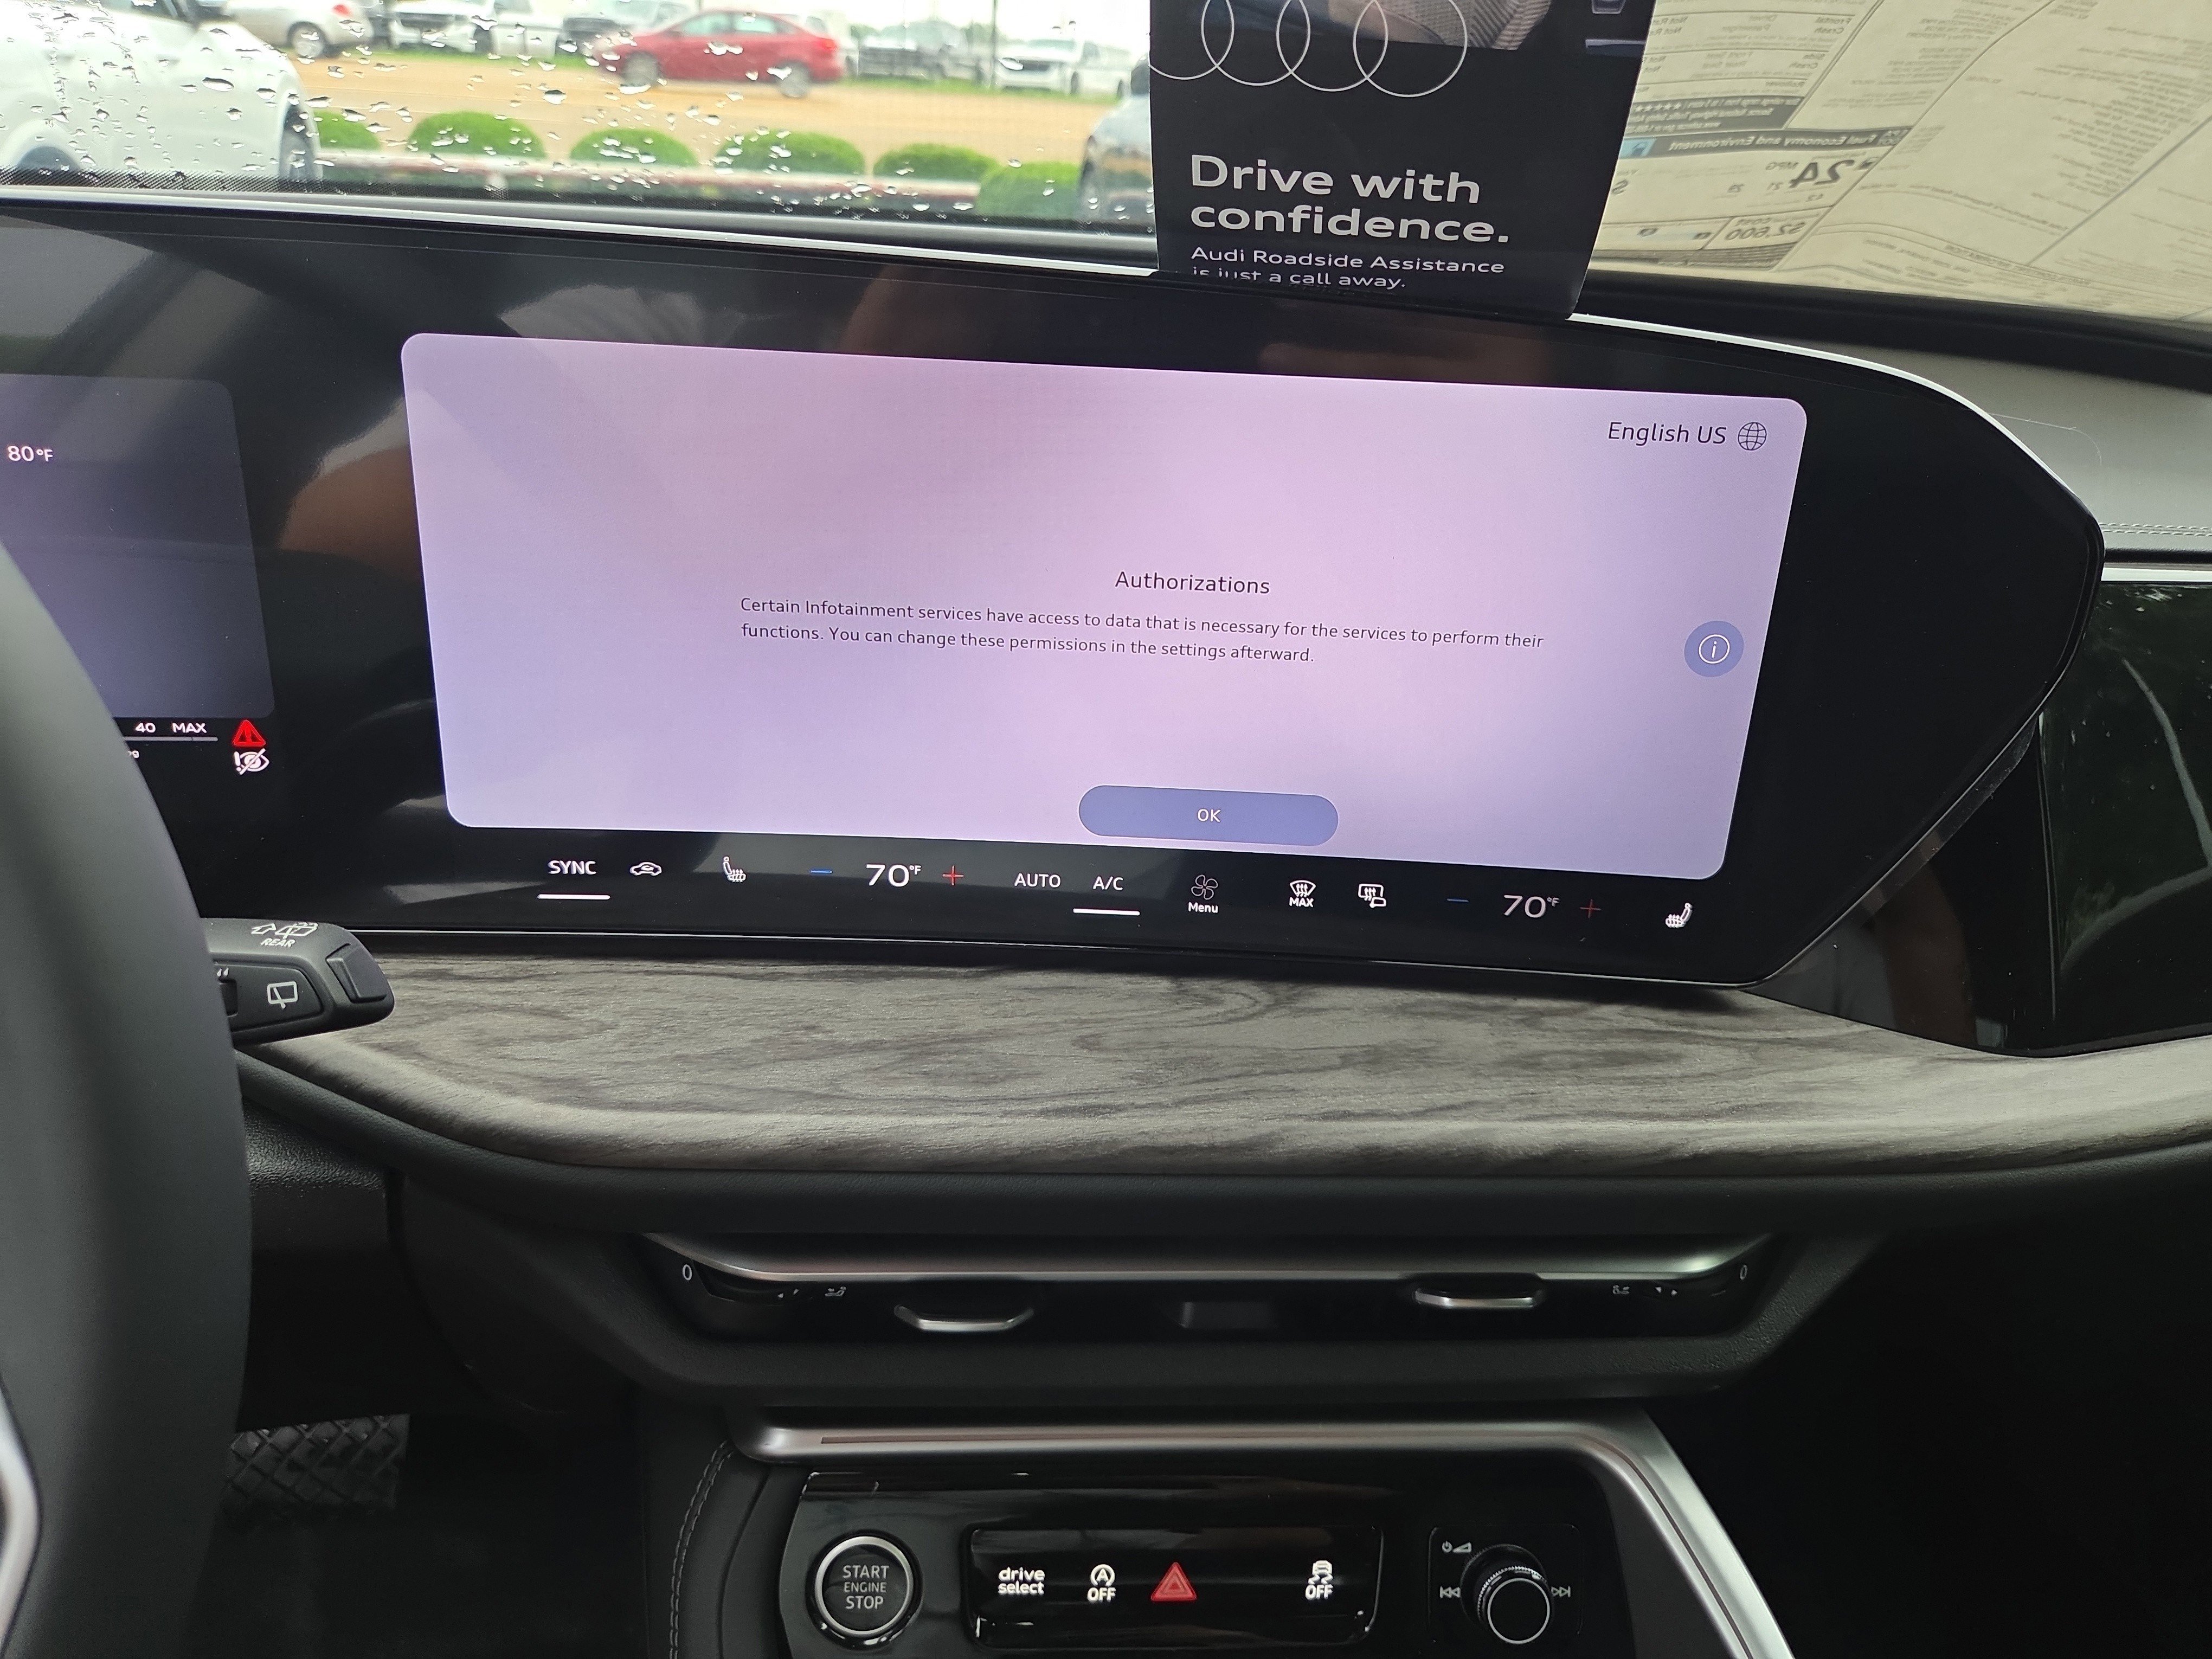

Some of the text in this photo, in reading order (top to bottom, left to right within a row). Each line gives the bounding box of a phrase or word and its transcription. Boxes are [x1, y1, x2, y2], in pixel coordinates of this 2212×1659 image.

[1192, 155, 1480, 203] Drive with
[1191, 204, 1509, 243] confidence.
[1191, 247, 1505, 273] Audi Roadside Assistance
[1269, 273, 1281, 283] a
[1290, 272, 1332, 285] call
[1339, 276, 1405, 290] away.
[1608, 421, 1727, 447] English US
[7, 446, 54, 462] 80°F
[1115, 571, 1270, 594] Authorizations
[741, 598, 1544, 647] Certain Infotainment services have access to data that is necessary for the services to perform their
[741, 623, 1313, 661] functions. You can change these permissions in the settings afterward.
[135, 722, 156, 733] 40
[171, 722, 208, 734] MAX
[1197, 808, 1221, 823] OK
[548, 860, 597, 876] SYNC
[866, 864, 922, 888] 70°F
[1014, 872, 1061, 888] AUTO
[1092, 876, 1124, 891] A/C
[1188, 902, 1219, 914] Menu
[1289, 897, 1314, 908] MAX
[1503, 895, 1560, 918] 70°F
[260, 938, 296, 948] REAR
[842, 1565, 890, 1579] START
[998, 1566, 1045, 1582] drive
[844, 1581, 887, 1594] ENGINE
[998, 1581, 1045, 1595] select
[1086, 1587, 1116, 1602] OFF
[1305, 1584, 1334, 1600] OFF
[845, 1595, 884, 1610] STOP
